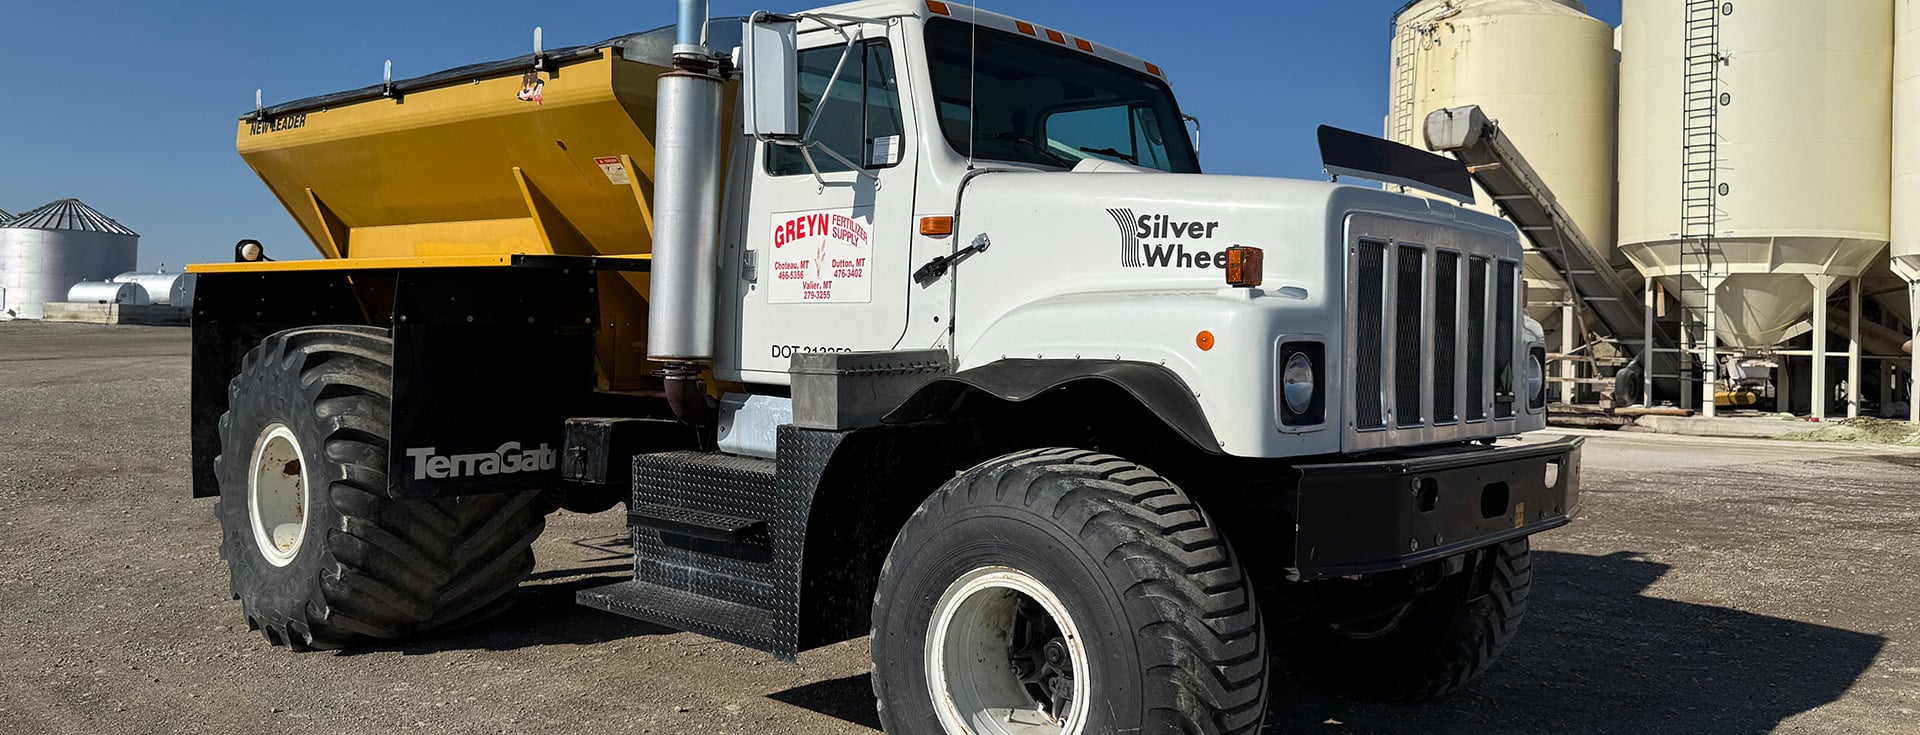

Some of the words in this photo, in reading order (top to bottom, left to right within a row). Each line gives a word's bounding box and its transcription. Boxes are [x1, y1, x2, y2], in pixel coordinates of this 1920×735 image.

[250, 121, 270, 136] NEW
[271, 112, 307, 132] LEADER
[774, 213, 829, 248] GREYN
[832, 214, 868, 245] FERTILIZER
[1136, 214, 1219, 239] Silver
[832, 226, 859, 247] SUPPLY
[774, 261, 799, 270] Choteau,
[800, 260, 809, 269] MT
[832, 258, 854, 269] Dutton,
[856, 257, 866, 267] MT
[833, 268, 862, 278] 476-3402
[802, 281, 821, 290] Valier,
[823, 280, 832, 289] MT
[803, 290, 831, 300] 279-3255
[772, 345, 800, 358] DOT
